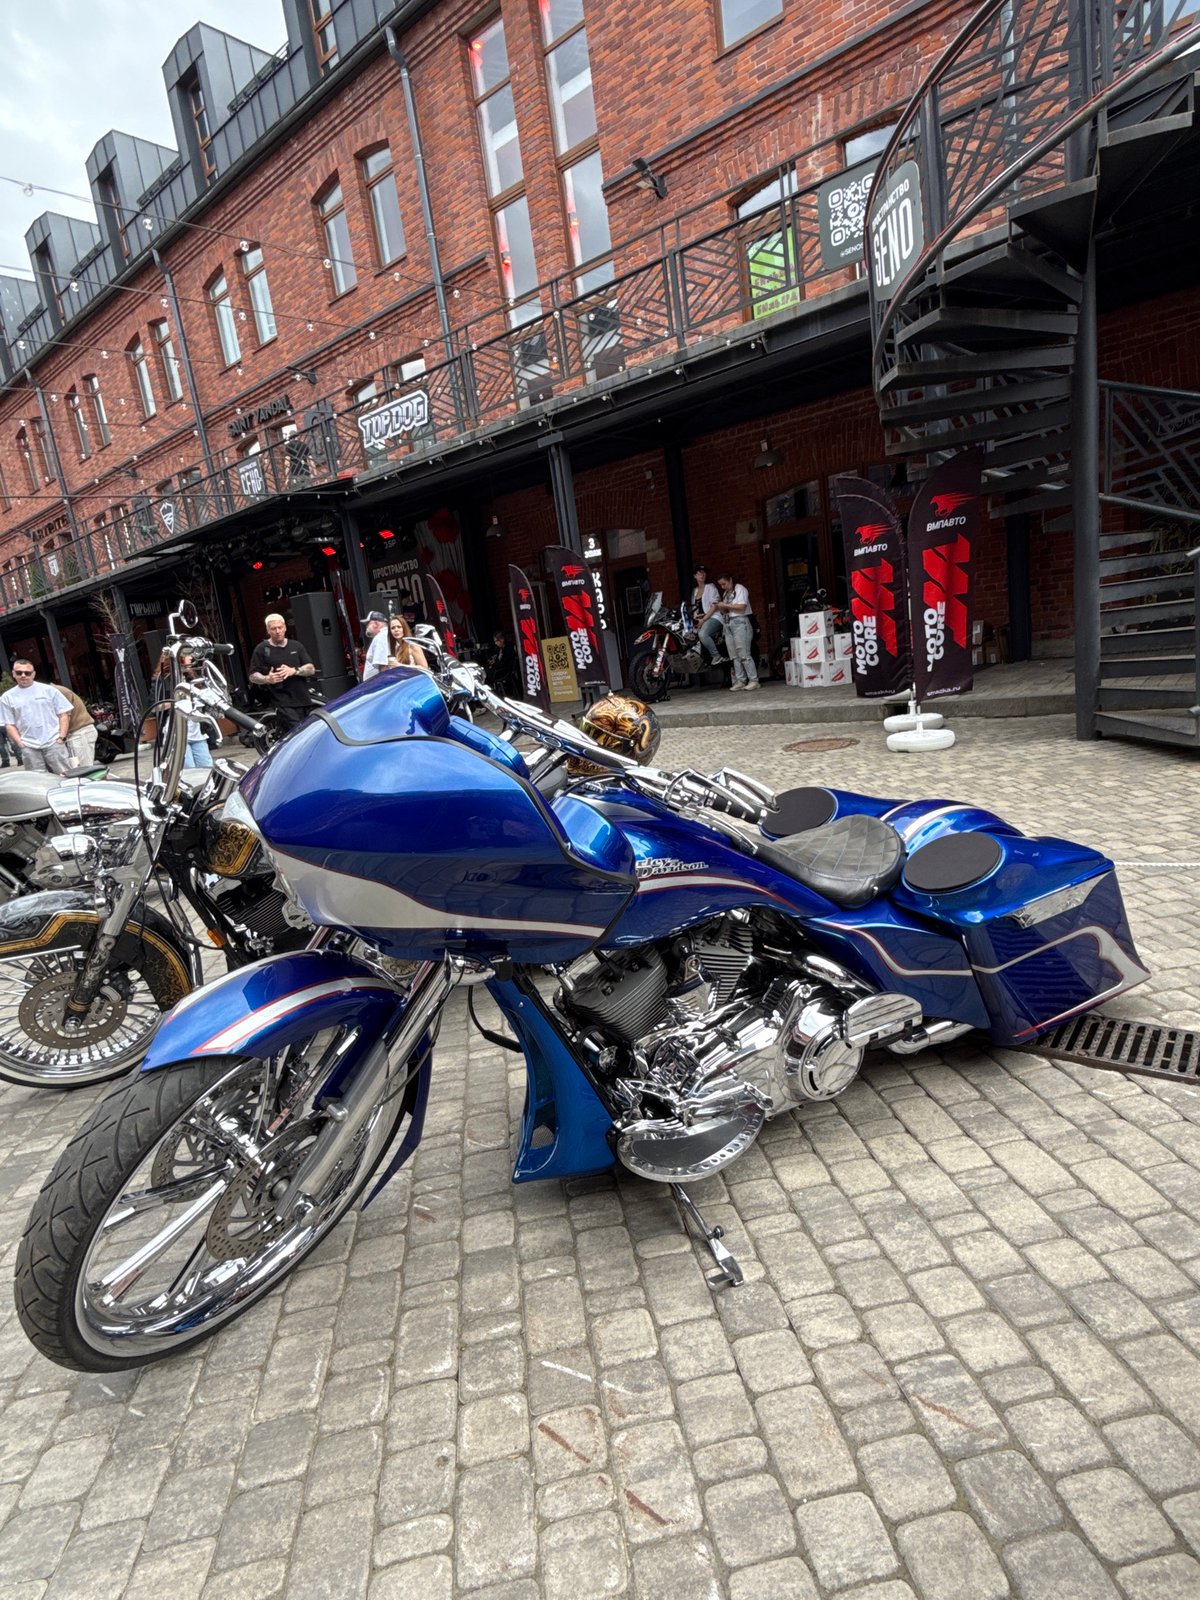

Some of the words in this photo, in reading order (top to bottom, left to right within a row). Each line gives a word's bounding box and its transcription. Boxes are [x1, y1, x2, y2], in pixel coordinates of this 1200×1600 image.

[873, 198, 914, 287] SENO
[926, 516, 966, 532] ВМПАВТО
[854, 543, 888, 556] ВМПАВТО
[570, 631, 587, 669] MOTO
[577, 627, 593, 663] CORE
[853, 620, 867, 675] MOTO
[863, 615, 879, 666] CORE
[526, 656, 537, 696] MOTO
